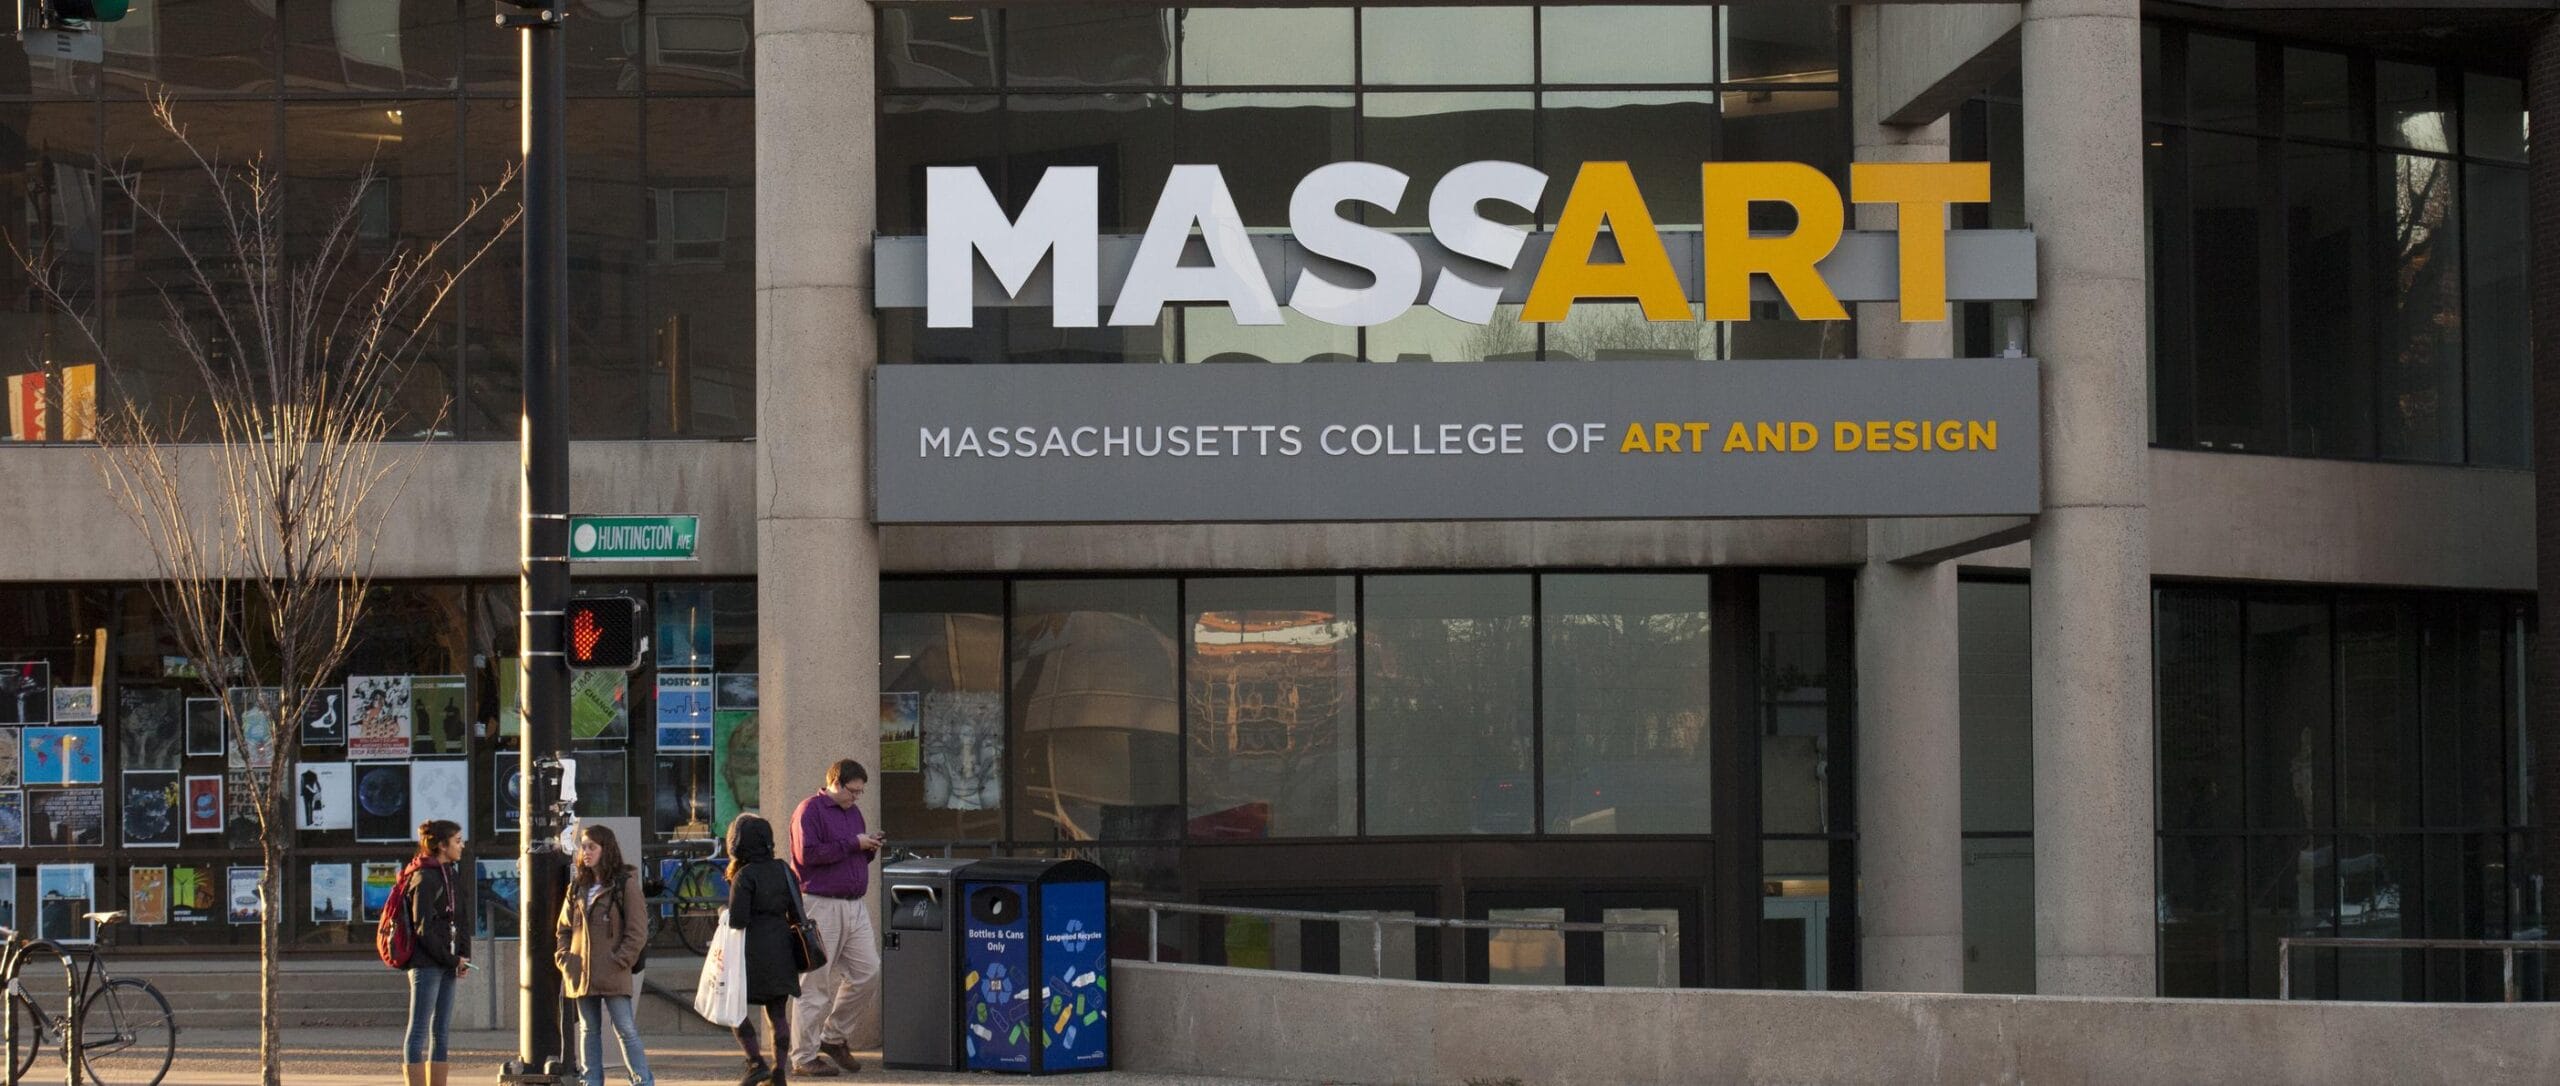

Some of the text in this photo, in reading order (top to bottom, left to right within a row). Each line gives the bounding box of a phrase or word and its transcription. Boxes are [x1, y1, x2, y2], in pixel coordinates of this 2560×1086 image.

[926, 160, 1991, 329] MASSART
[920, 420, 1998, 458] MASSACHUSETTS COLLEGE OF ART AND DESIGN
[598, 524, 693, 550] HUNTINGTON AVE
[570, 670, 597, 697] CLIMA
[584, 688, 615, 717] CHANGE
[968, 929, 1024, 939] Bottles & Cans
[987, 941, 1006, 953] Only
[1078, 932, 1102, 941] Recycles
